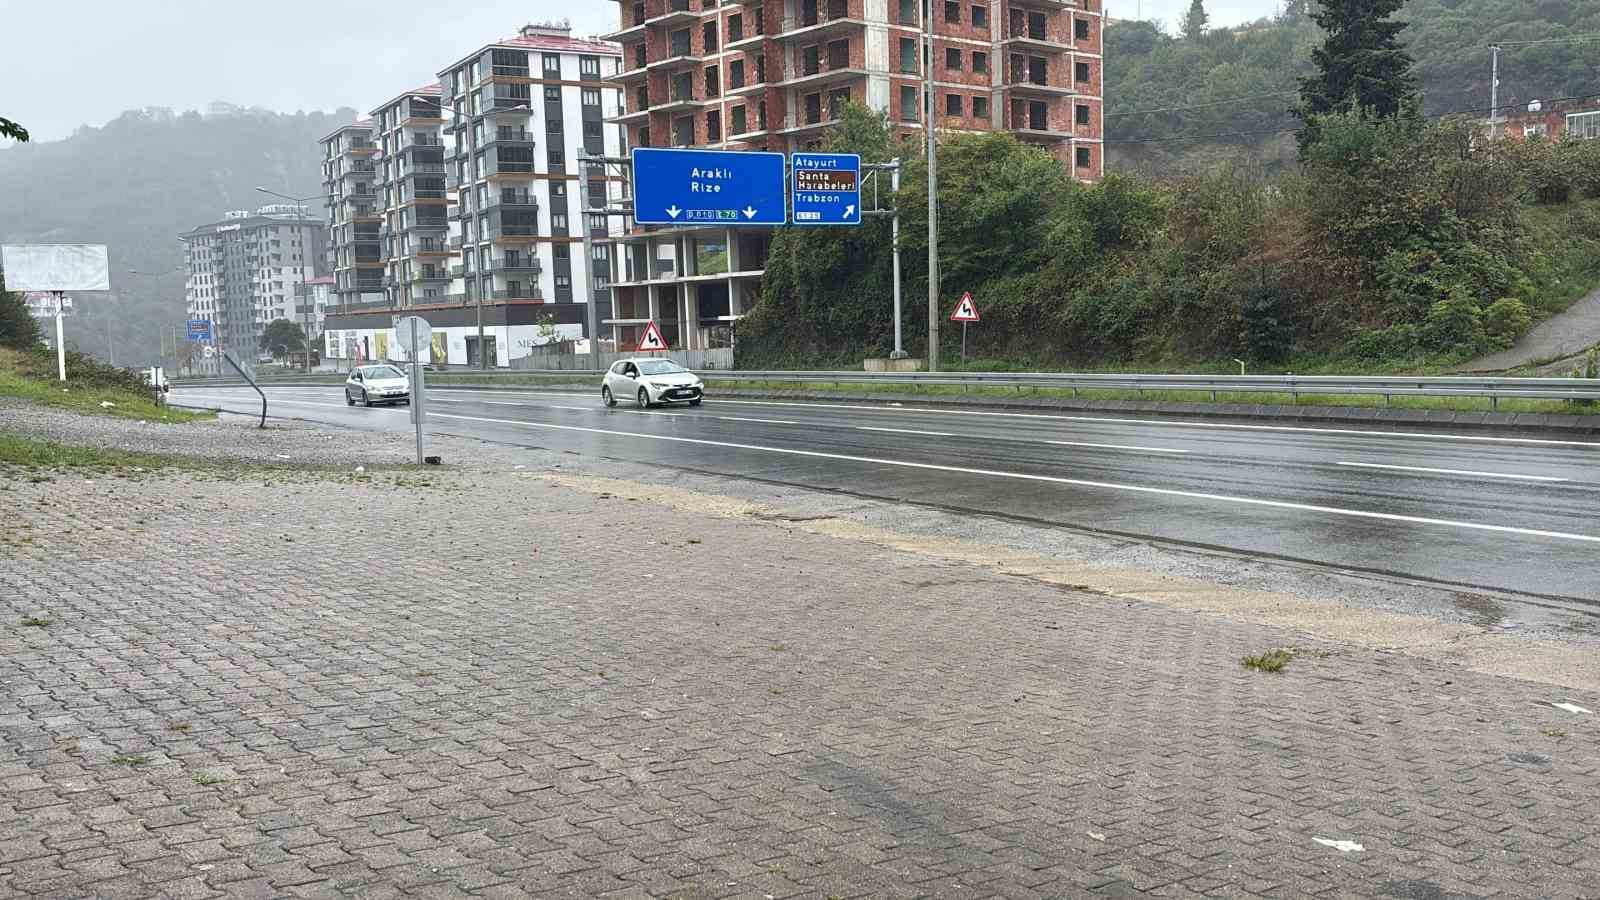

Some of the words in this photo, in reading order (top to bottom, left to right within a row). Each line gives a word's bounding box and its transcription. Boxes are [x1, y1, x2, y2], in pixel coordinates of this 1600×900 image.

[796, 157, 837, 169] Atayurt
[691, 167, 732, 179] Araklı
[799, 171, 829, 180] Santa
[691, 181, 721, 193] Rize
[795, 193, 840, 203] Trabzon
